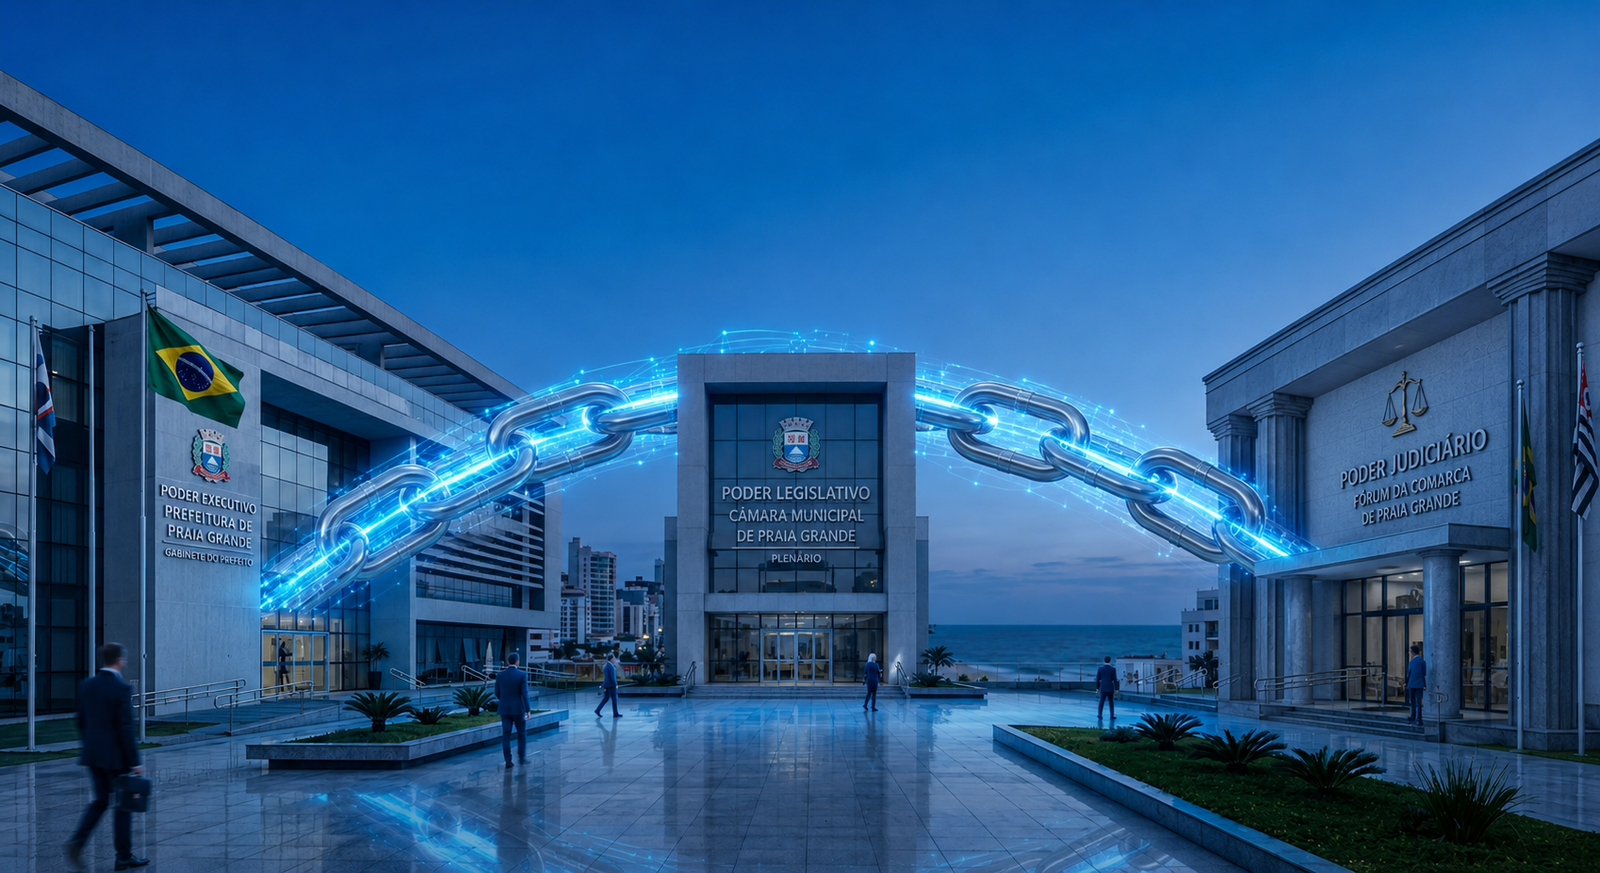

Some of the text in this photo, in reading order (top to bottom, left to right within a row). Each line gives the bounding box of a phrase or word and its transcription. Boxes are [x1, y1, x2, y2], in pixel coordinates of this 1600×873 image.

[1340, 429, 1488, 489] PODER JUDICIÁRIO
[722, 486, 870, 500] PODER LEGISLATIVO
[1354, 466, 1471, 508] FÓRUM DA COMARCA
[161, 485, 256, 514] PODER EXECUTIVO
[1362, 491, 1460, 525] DE PRAIA GRANDE
[165, 505, 252, 532] PREFEITURA DE
[729, 507, 864, 522] CÂMARA MUNICIPAL
[168, 524, 251, 548] PRAIA GRANDE
[737, 530, 856, 542] DE PRAIA GRANDE
[165, 548, 205, 560] GABINETE
[207, 554, 218, 562] DO
[772, 551, 821, 563] PLENÁRIO
